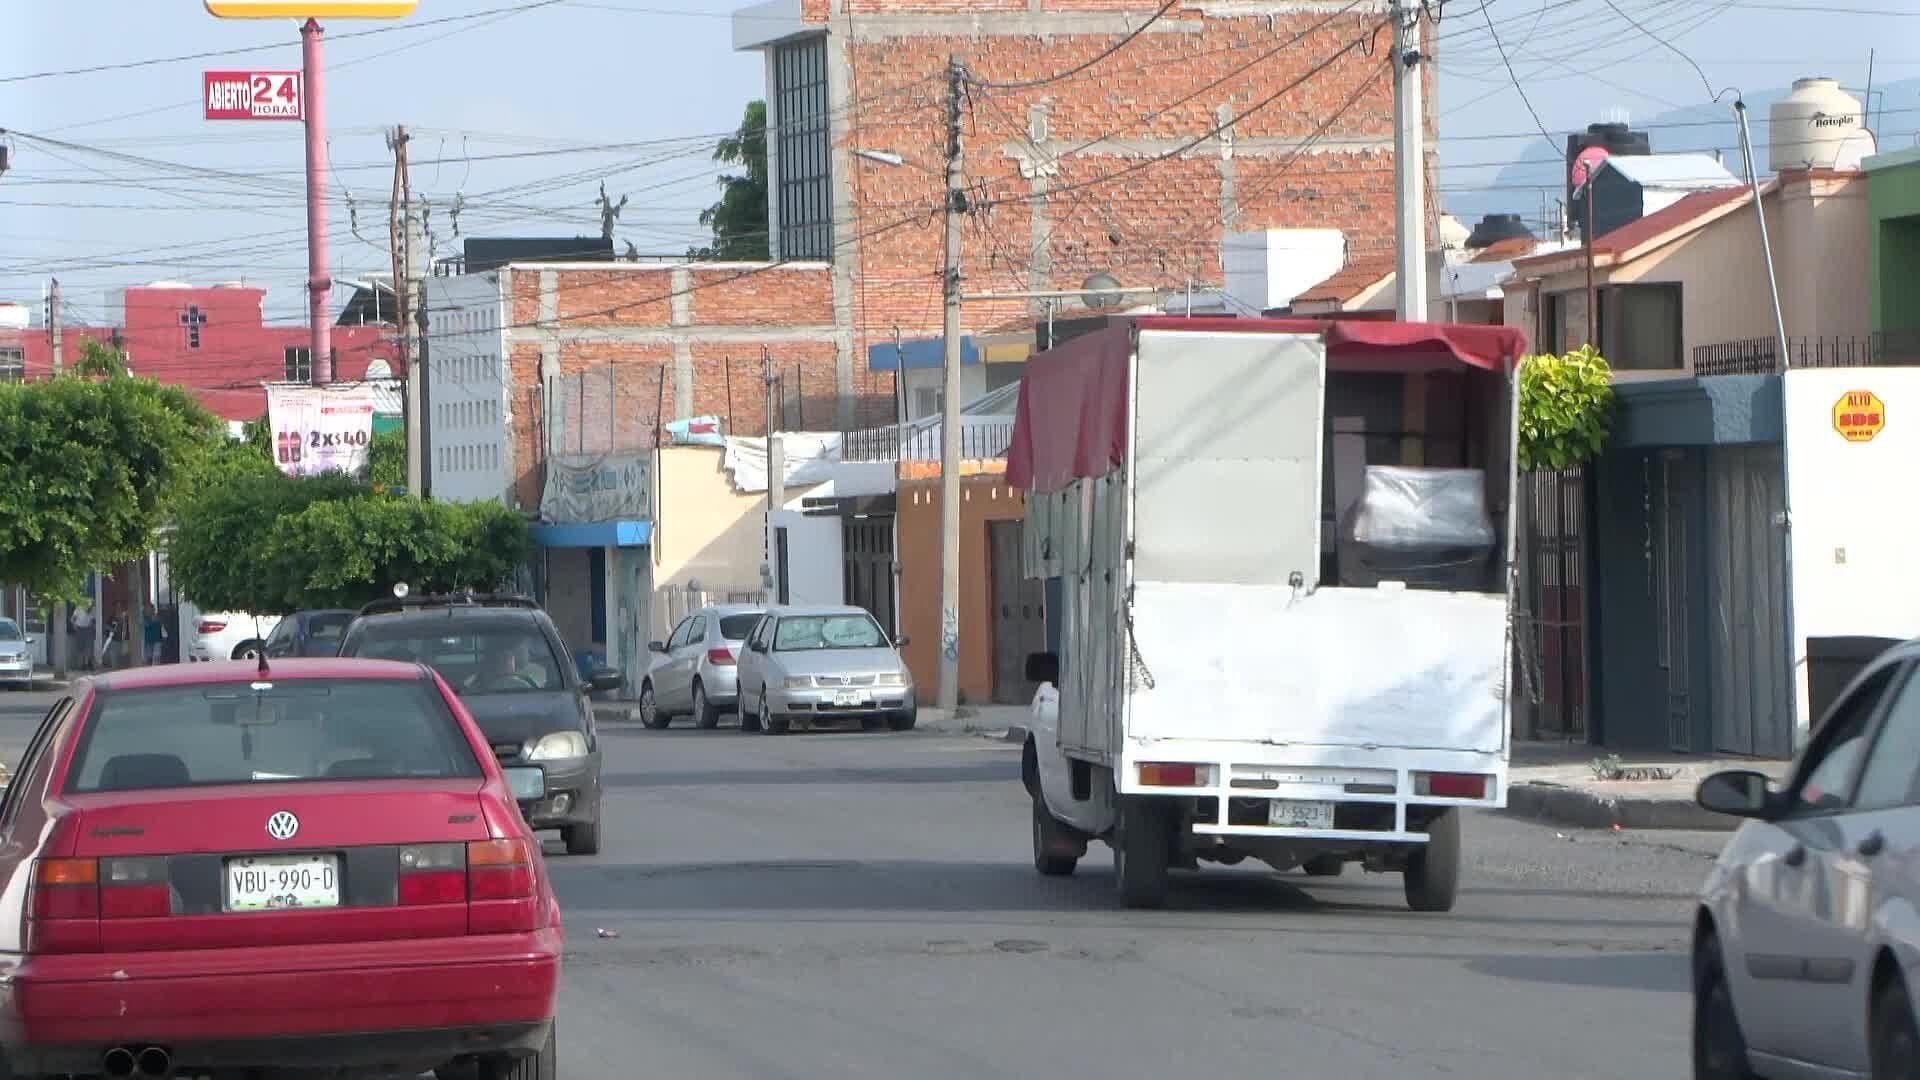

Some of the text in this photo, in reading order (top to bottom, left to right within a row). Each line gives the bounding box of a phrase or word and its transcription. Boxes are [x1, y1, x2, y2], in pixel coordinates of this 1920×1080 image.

[208, 77, 296, 111] ABIERTO 24
[253, 105, 297, 114] HORAS
[1847, 394, 1871, 407] ALTO
[233, 867, 334, 894] VBU-990-D
